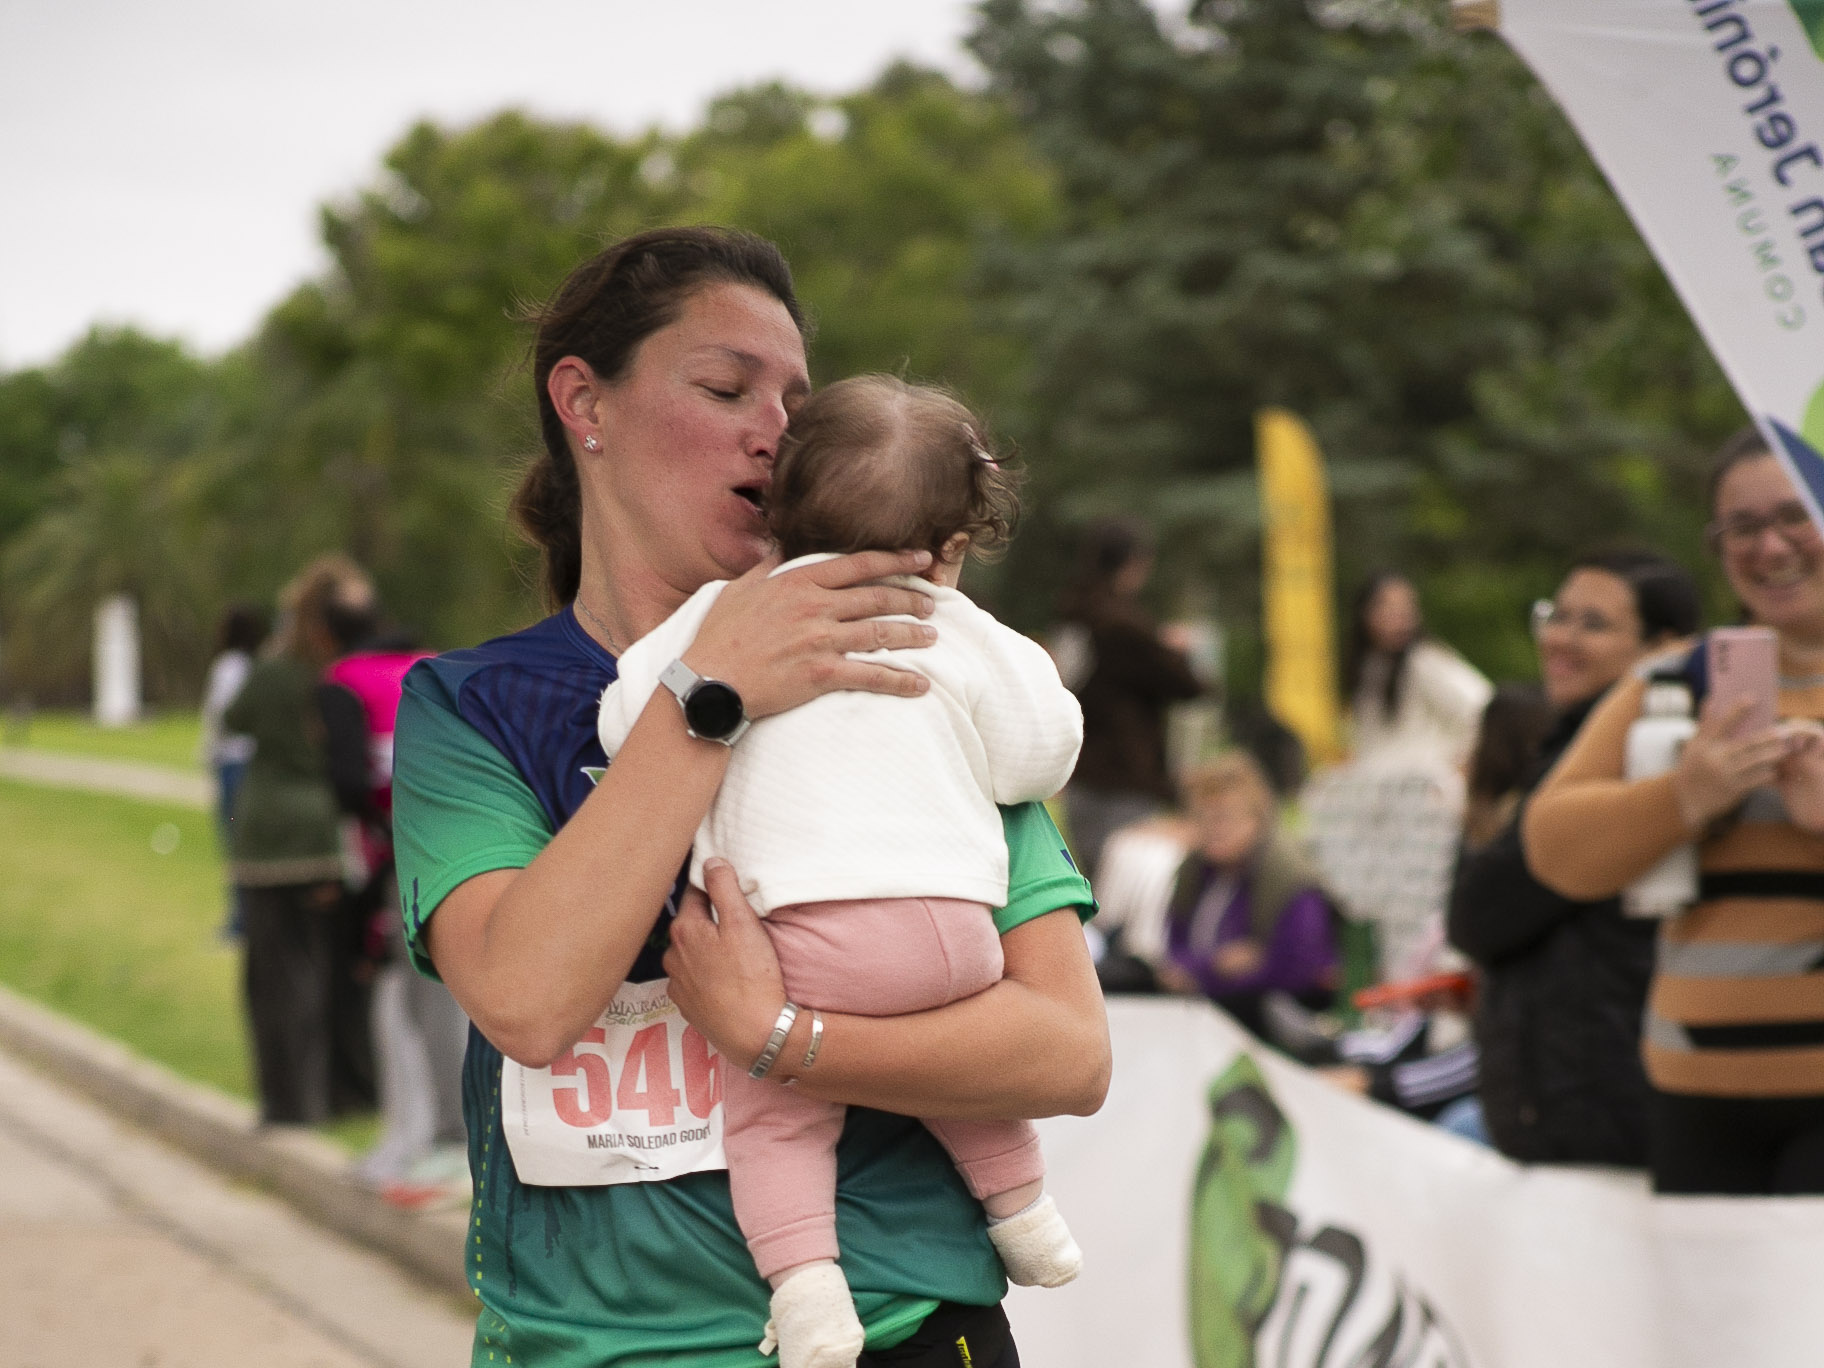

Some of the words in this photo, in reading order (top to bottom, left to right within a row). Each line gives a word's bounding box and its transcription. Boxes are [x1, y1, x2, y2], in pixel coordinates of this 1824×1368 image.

[551, 1021, 723, 1128] 546
[587, 1133, 625, 1149] MARIA
[626, 1132, 677, 1150] SOLEDAD
